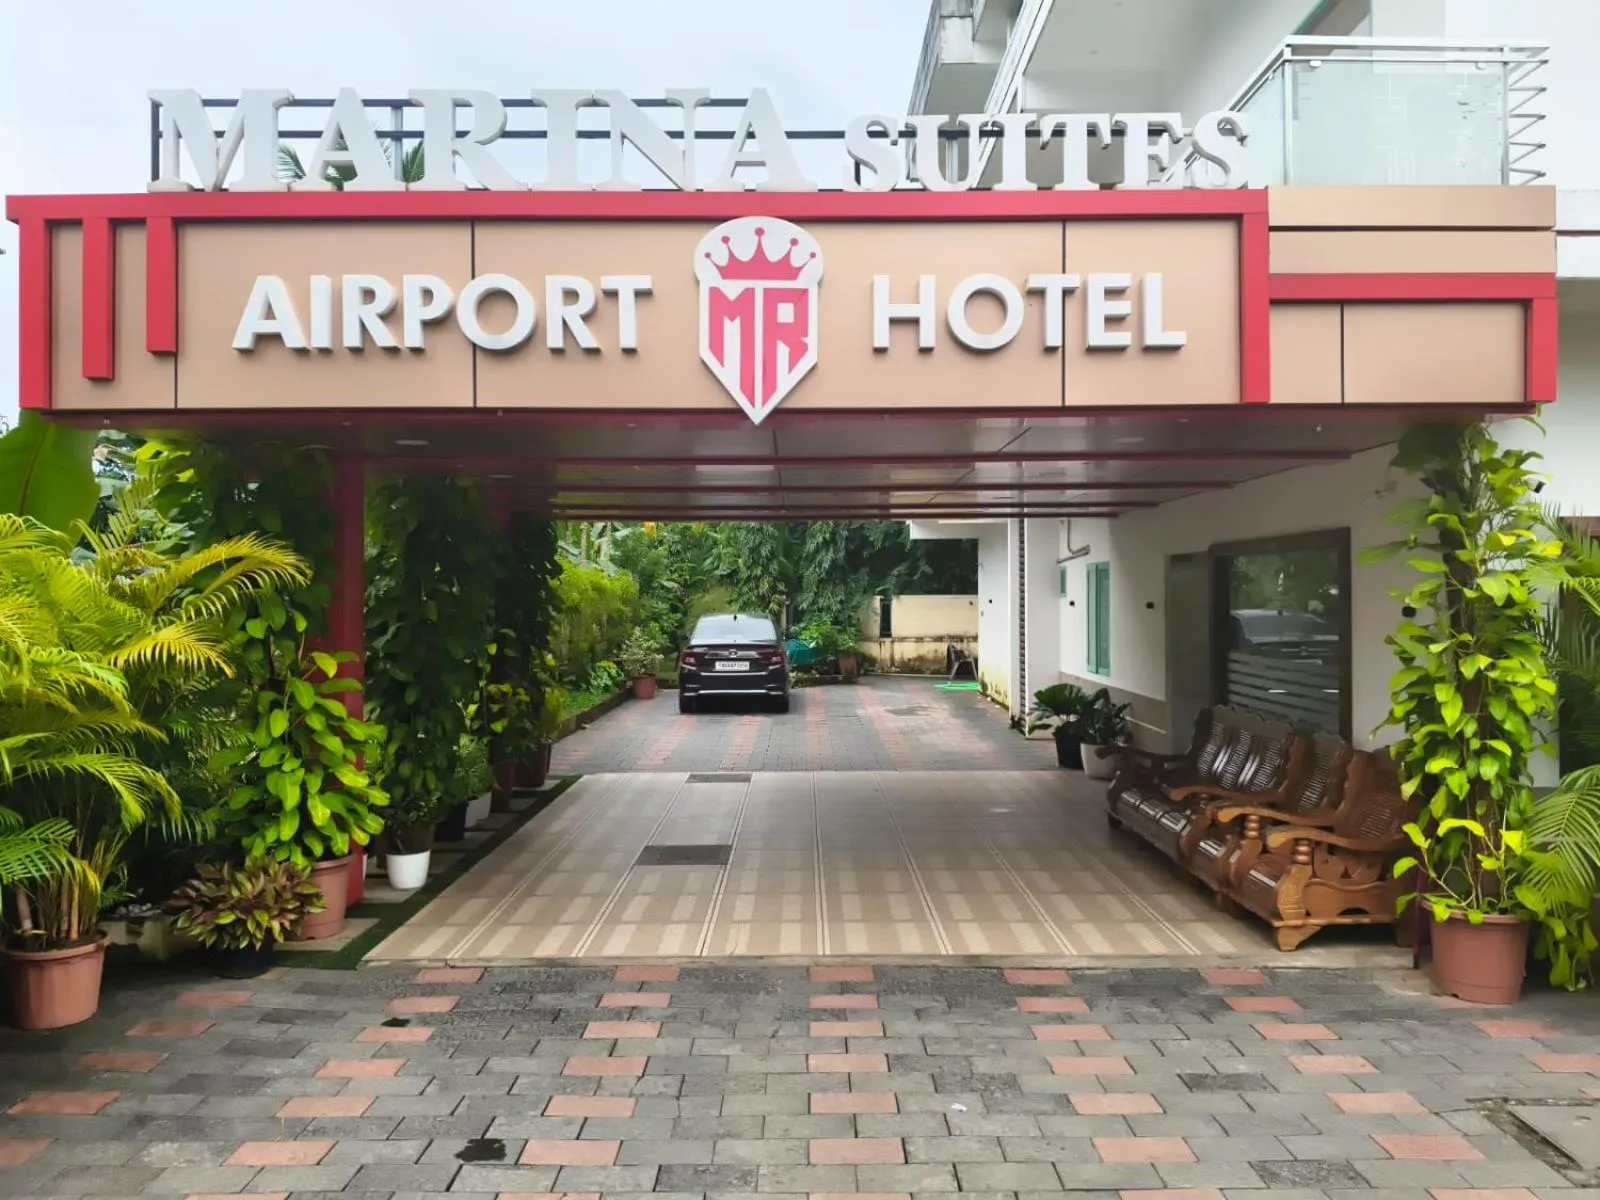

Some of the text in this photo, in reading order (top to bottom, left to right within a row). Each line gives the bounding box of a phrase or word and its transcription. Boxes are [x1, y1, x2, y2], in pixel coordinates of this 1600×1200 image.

[147, 87, 1249, 192] MARINA SUITES
[232, 273, 1187, 352] AIRPORT HOTEL
